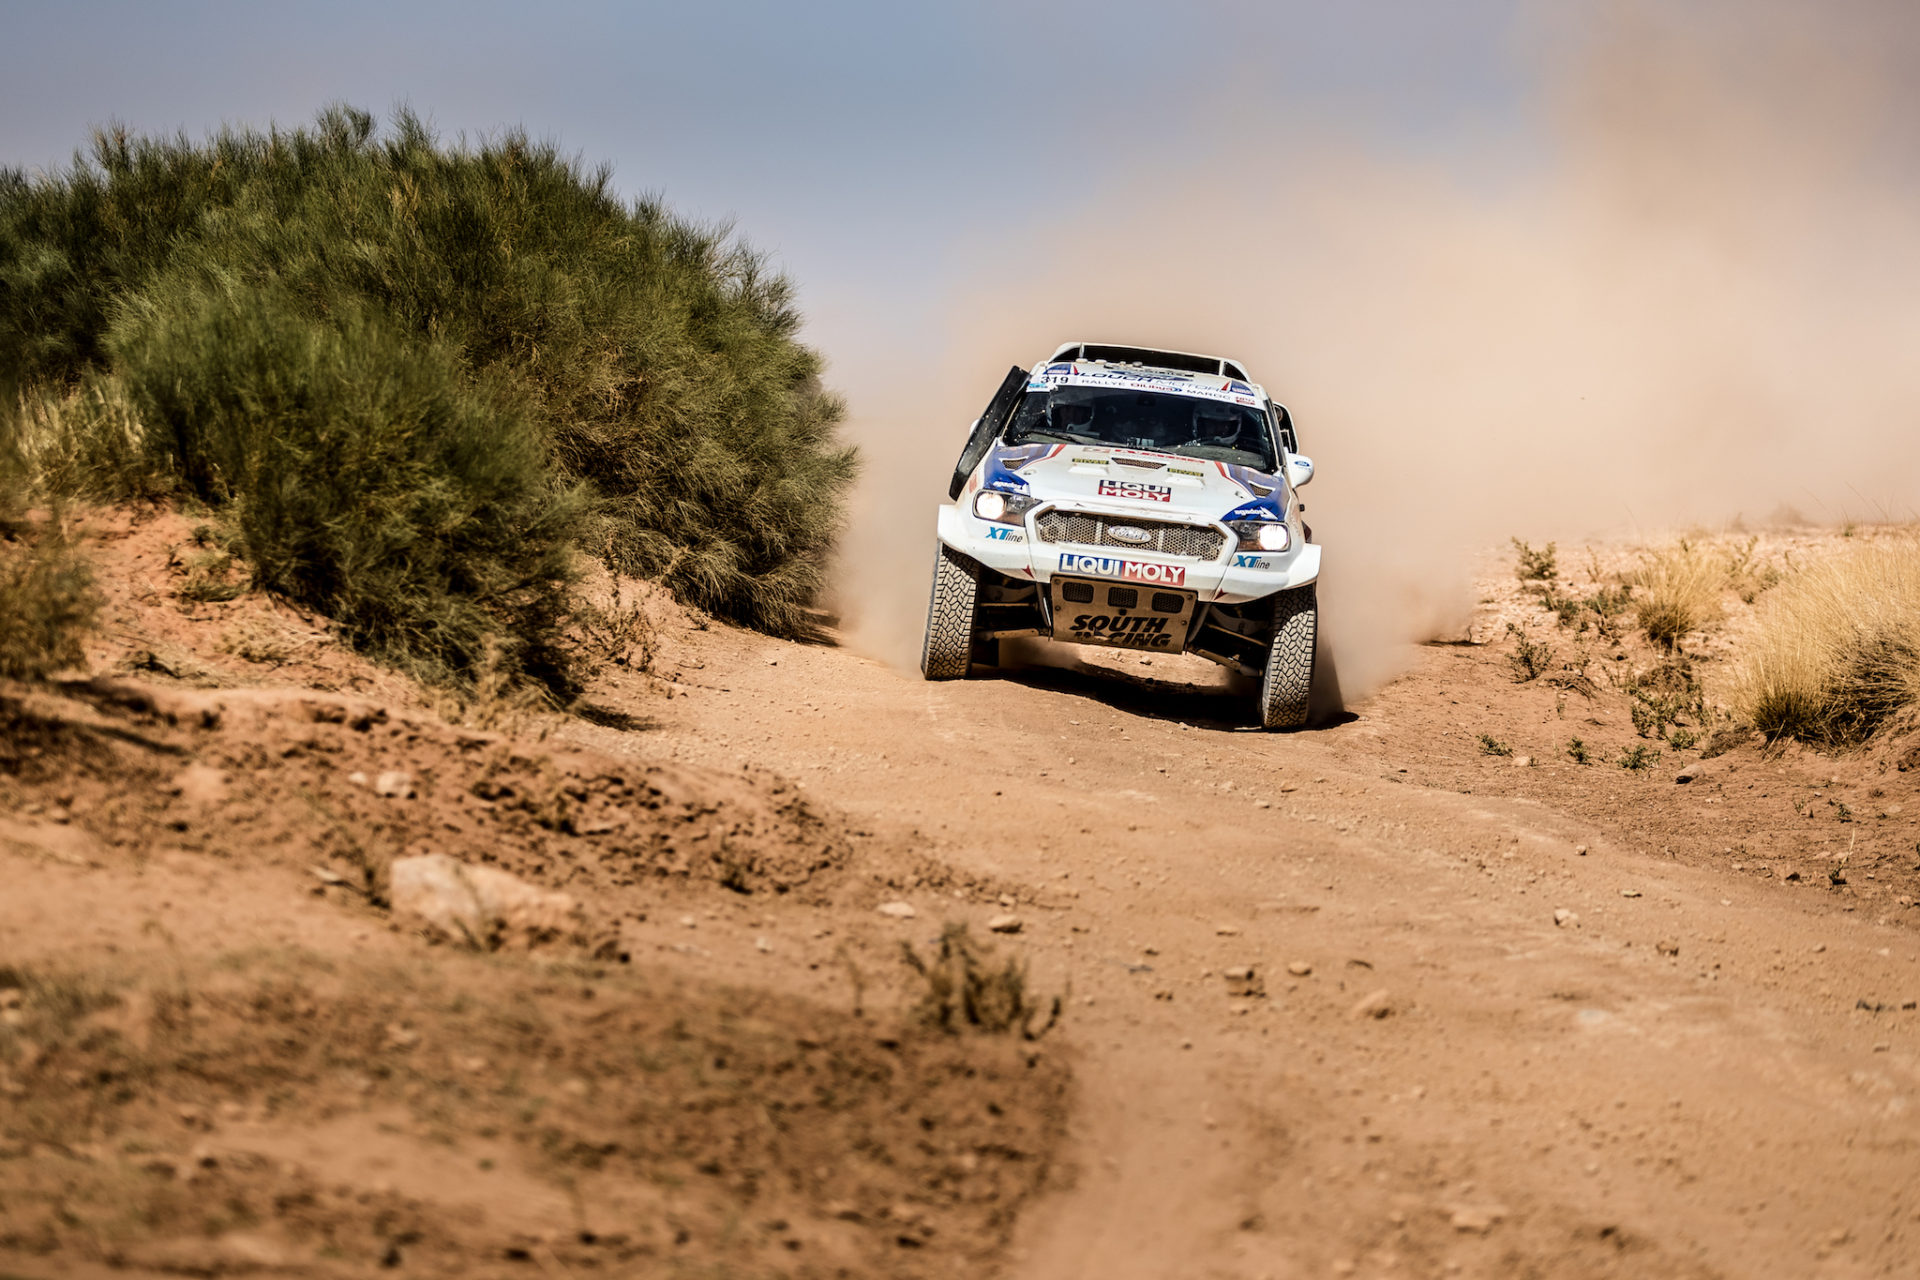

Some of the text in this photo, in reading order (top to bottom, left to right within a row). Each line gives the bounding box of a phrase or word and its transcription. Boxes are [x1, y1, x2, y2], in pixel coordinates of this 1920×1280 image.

[1041, 376, 1069, 384] 319
[1082, 379, 1125, 387] RALLYE
[1102, 480, 1170, 493] LIQUI
[1101, 487, 1170, 502] MOLY
[1061, 554, 1184, 583] LIQUI MOLY
[1070, 614, 1168, 633] SOUTH
[1073, 631, 1172, 648] RCING
